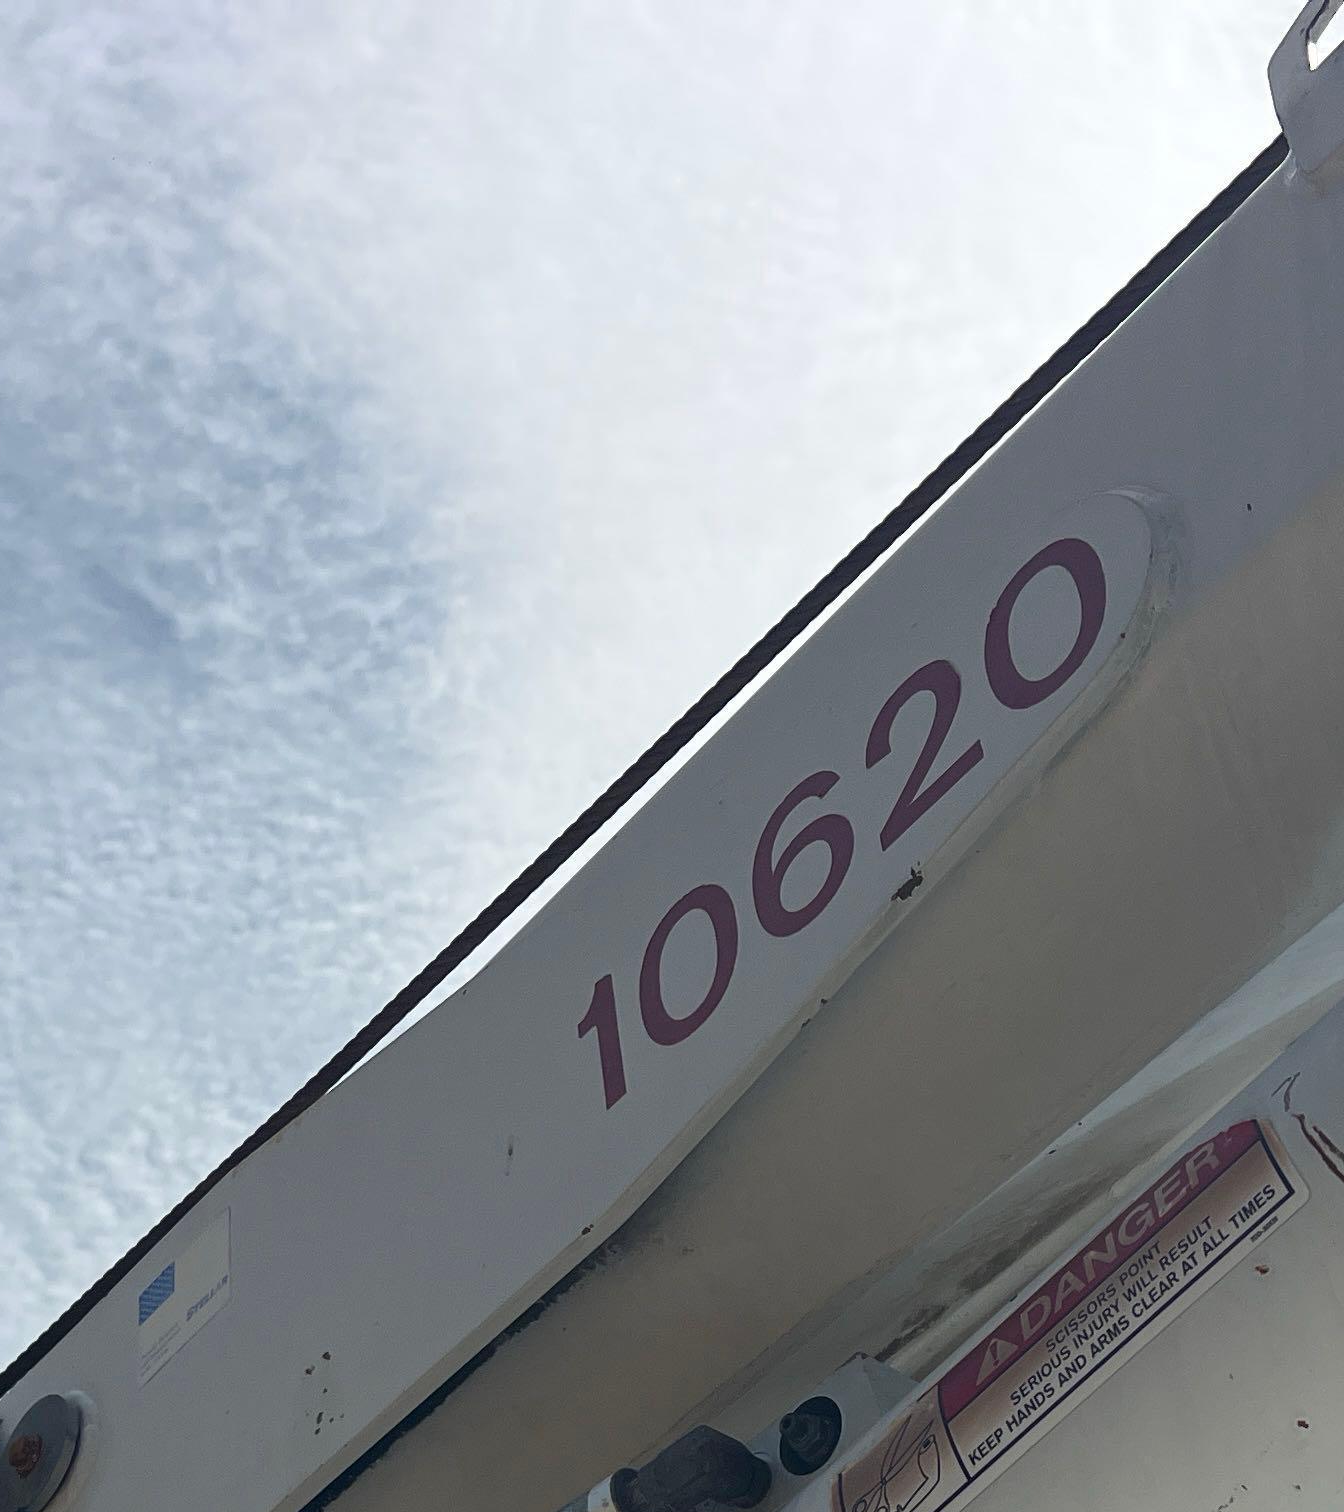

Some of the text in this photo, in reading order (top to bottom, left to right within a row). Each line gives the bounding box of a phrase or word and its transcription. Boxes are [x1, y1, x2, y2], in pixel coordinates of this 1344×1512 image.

[578, 538, 1107, 1111] 10620
[968, 1427, 1002, 1465] KEEP
[1005, 1382, 1054, 1432] HANDS
[1058, 1354, 1086, 1387] AND
[1090, 1315, 1129, 1358] ARMS
[1131, 1271, 1179, 1317] CLEAR
[1182, 1251, 1197, 1276] AT
[1202, 1229, 1229, 1257] ALL
[1228, 1184, 1274, 1228] TIMES
[1010, 1346, 1070, 1405] SERIOUS
[1072, 1298, 1118, 1348] INJURY
[1122, 1270, 1157, 1301] WILL
[1158, 1216, 1211, 1270] RESULT
[1019, 1140, 1222, 1336] DANGER
[1046, 1240, 1159, 1352] SCISSORS POINT
